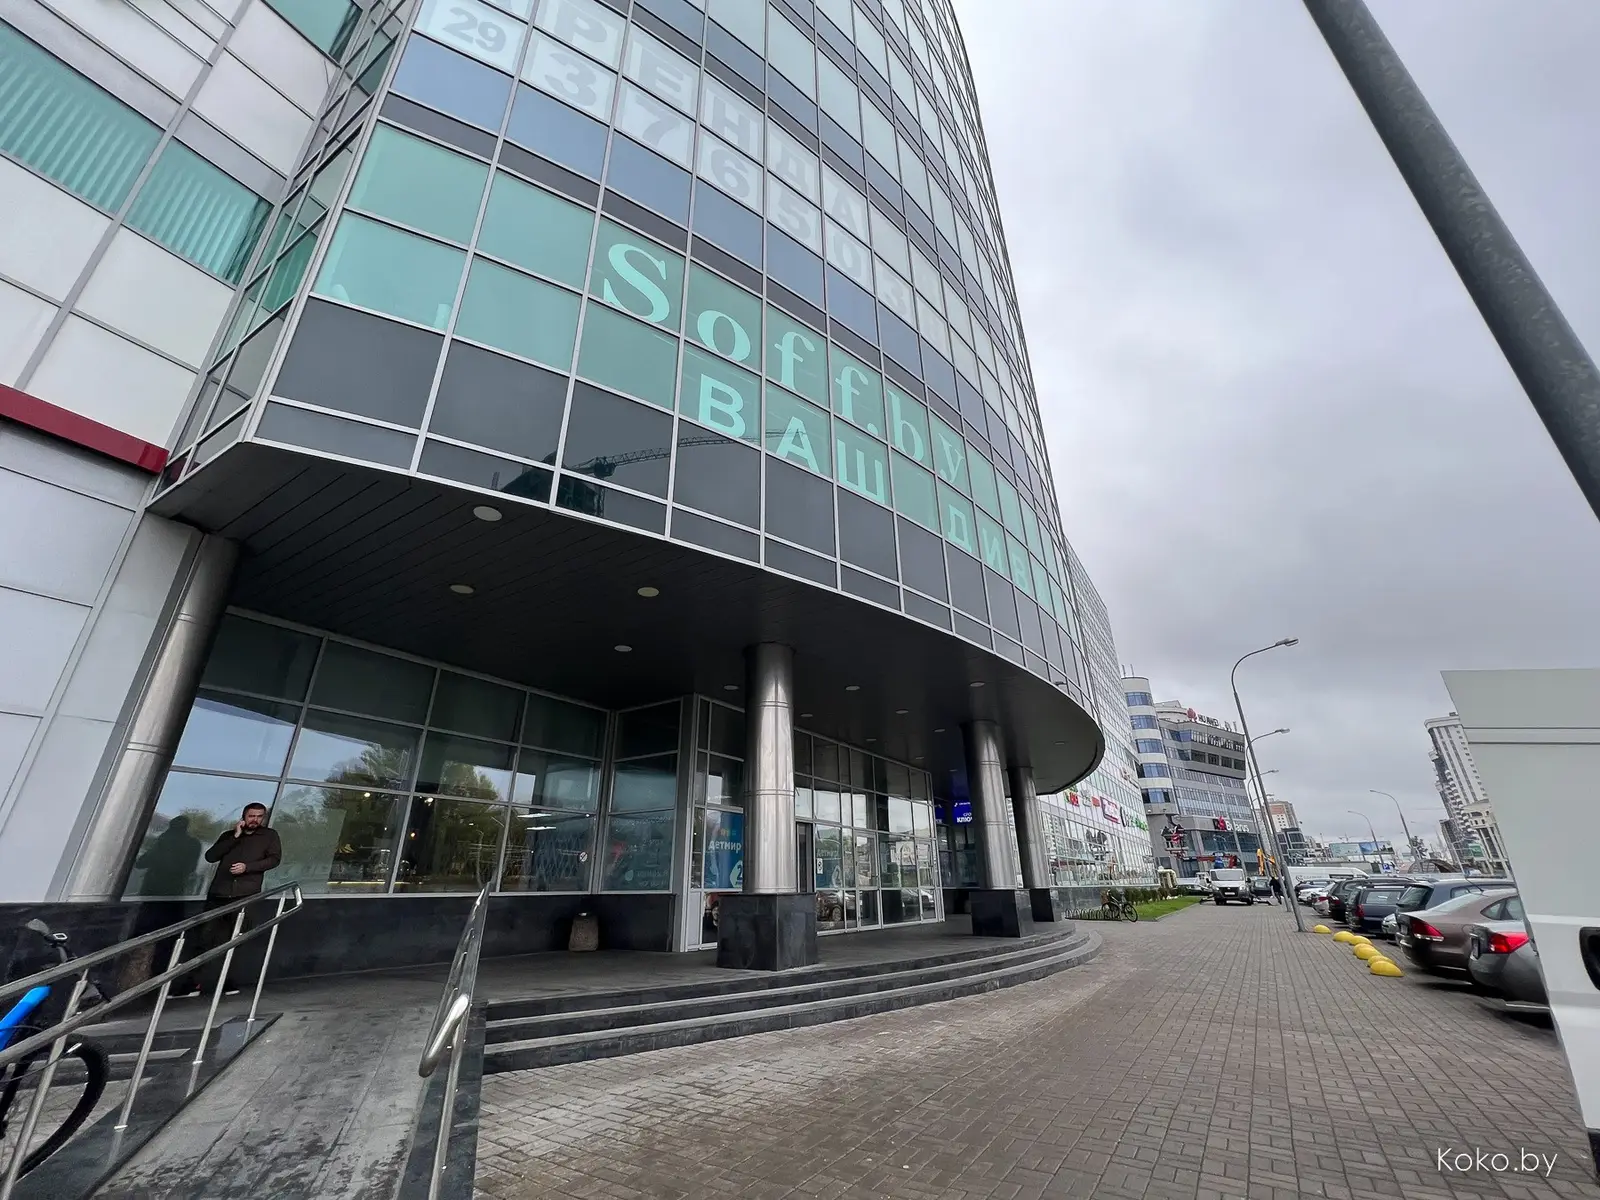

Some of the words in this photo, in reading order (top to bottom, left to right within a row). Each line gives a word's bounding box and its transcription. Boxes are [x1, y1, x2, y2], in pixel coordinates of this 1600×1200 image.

[444, 7, 507, 52] 29
[494, 0, 866, 234] РЕНДА
[603, 243, 966, 483] Soff.by
[699, 373, 887, 505] ВАШ
